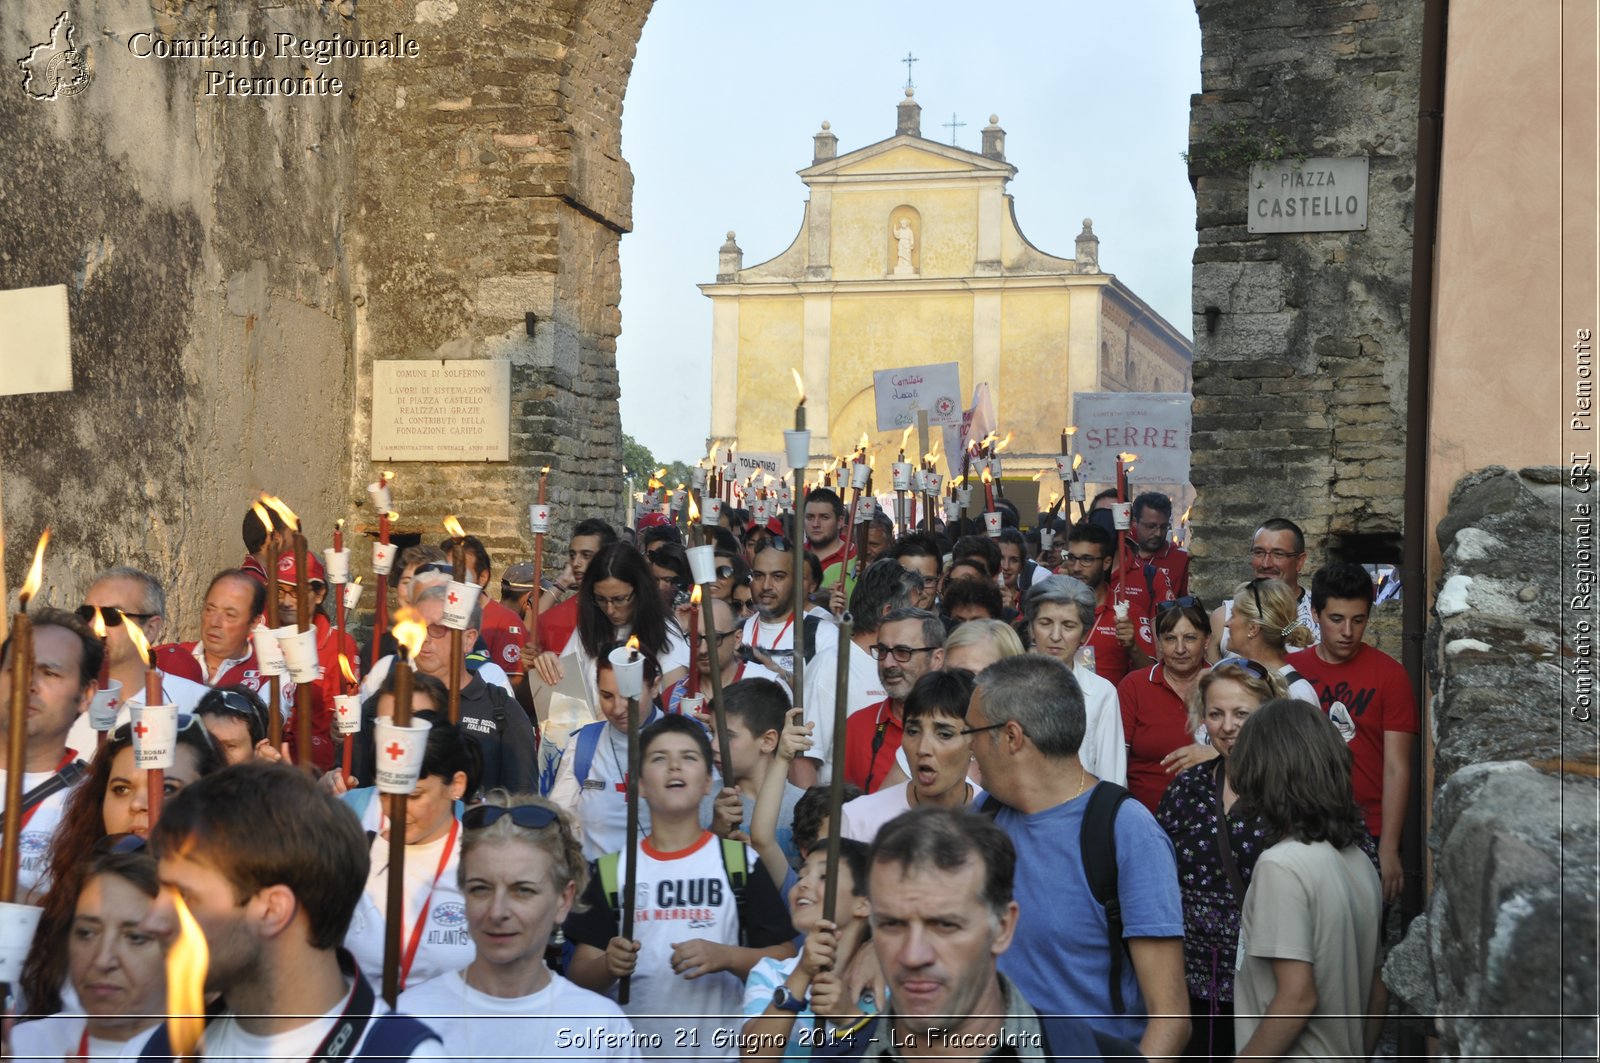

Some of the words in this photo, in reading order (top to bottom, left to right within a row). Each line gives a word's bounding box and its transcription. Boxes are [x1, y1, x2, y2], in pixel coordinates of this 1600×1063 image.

[1281, 171, 1336, 188] PIAZZA
[1257, 195, 1358, 218] CASTELLO
[396, 370, 427, 378] COMUNE
[431, 370, 440, 378] DI
[444, 369, 486, 378] SOLFERINO
[389, 386, 417, 395] LAVORI
[421, 387, 430, 395] DI
[434, 385, 492, 395] SISTEMAZIONE
[397, 396, 406, 405] DI
[409, 396, 440, 405] PIAZZA
[444, 396, 484, 404] CASTELLO
[399, 406, 447, 415] REALIZZATI
[451, 406, 481, 415] GRAZIE
[393, 416, 404, 425] AL
[408, 416, 457, 425] CONTRIBUTO
[461, 417, 486, 425] DELLA
[396, 427, 446, 435] FONDAZIONE
[450, 427, 483, 435] CARIPLO
[1085, 426, 1178, 450] SERRE
[739, 457, 776, 472] TOLENTINO
[462, 716, 481, 725] CROCE
[480, 718, 497, 730] ROSSA
[466, 723, 490, 734] ITALIANA
[656, 877, 723, 909] CLUB
[426, 928, 468, 946] ATLANTIS
